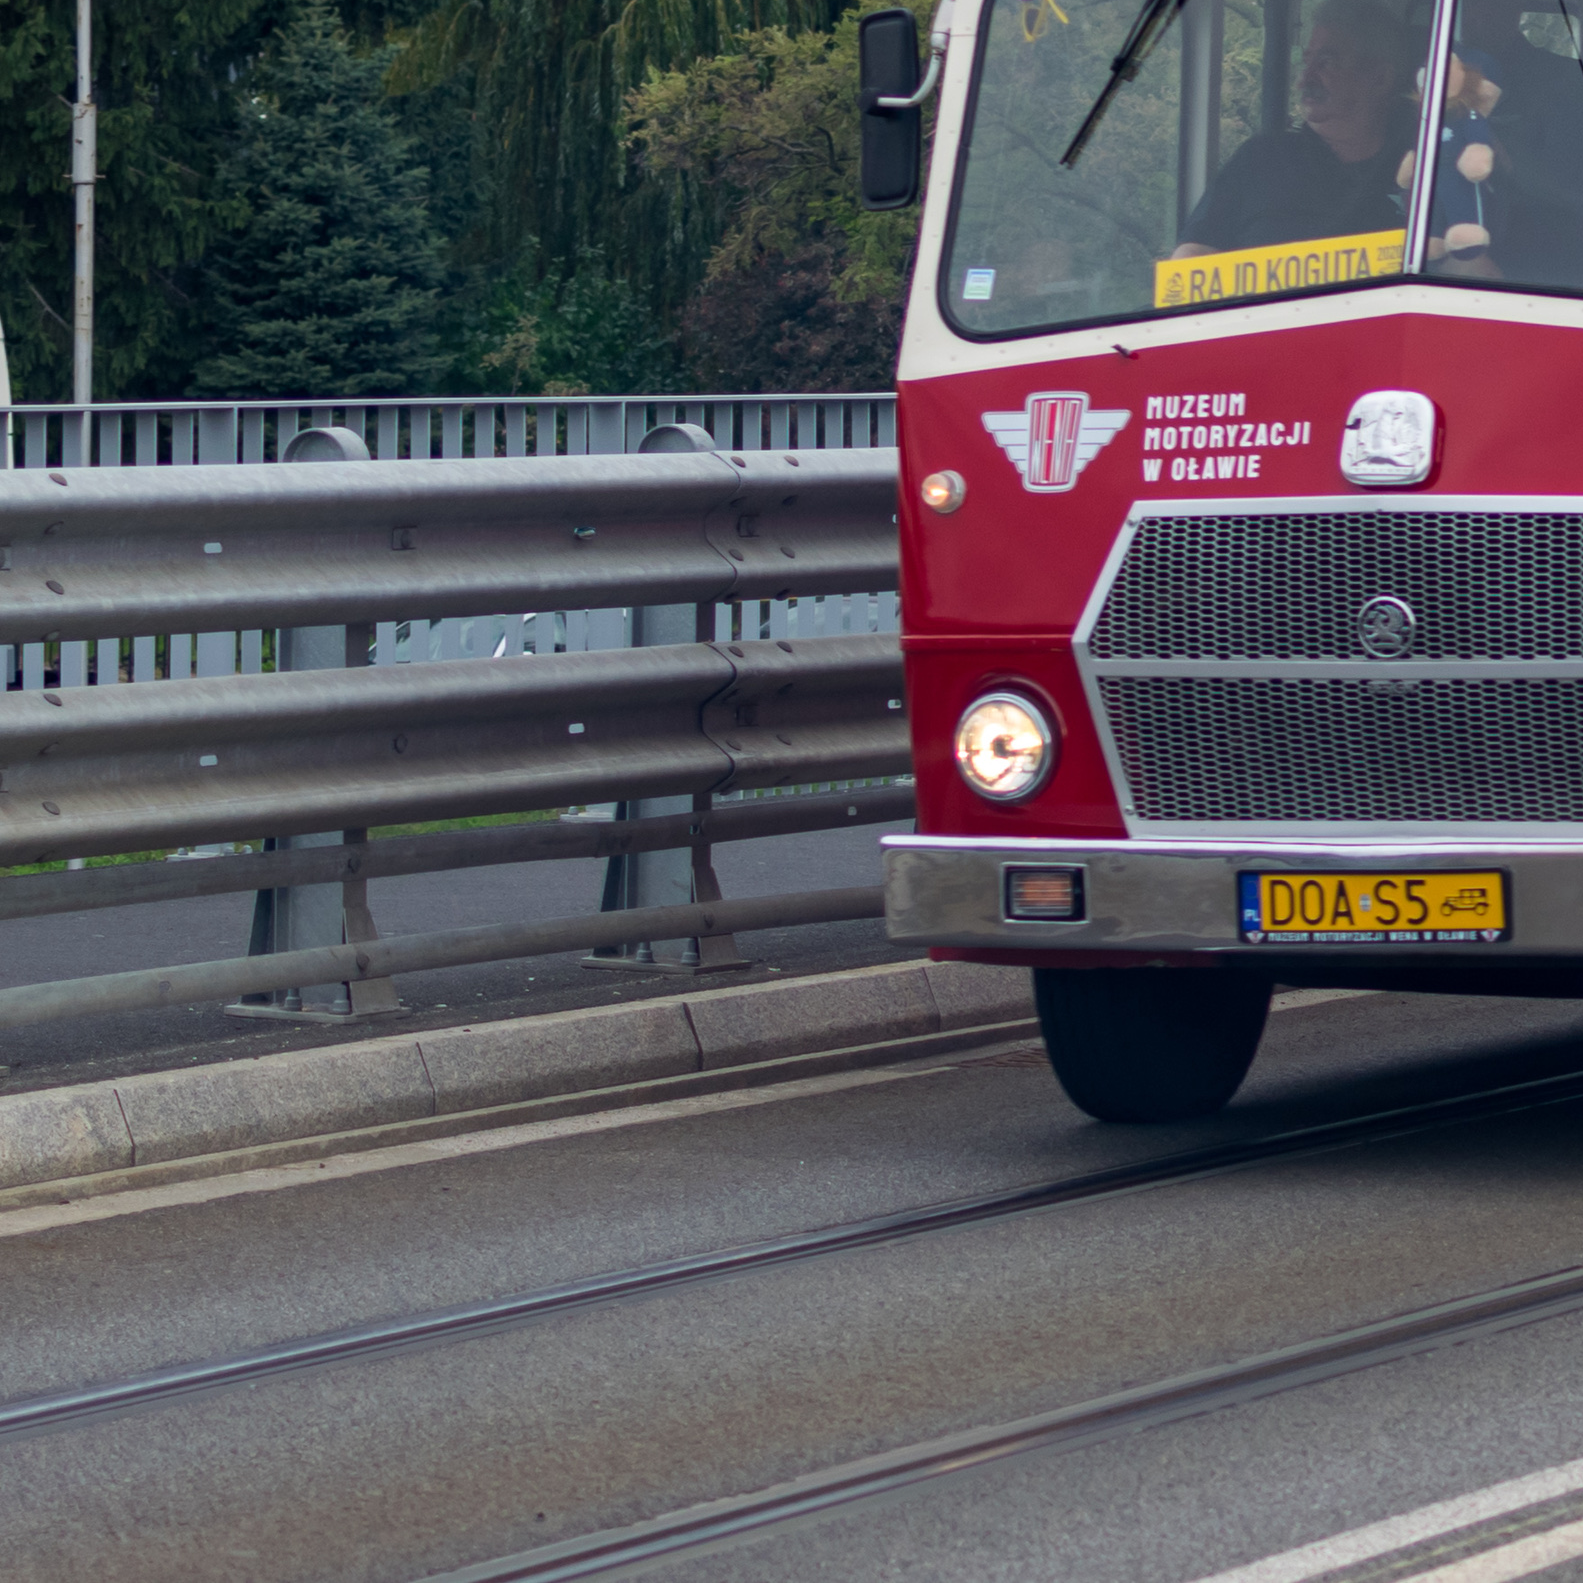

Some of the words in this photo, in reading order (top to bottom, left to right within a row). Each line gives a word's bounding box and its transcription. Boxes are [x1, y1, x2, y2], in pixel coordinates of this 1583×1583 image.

[1189, 261, 1258, 303] RAJD
[1265, 247, 1371, 293] KOGUTA
[1146, 393, 1246, 419] MUZEUM
[1144, 421, 1311, 451] MOTORYZACJI
[1142, 458, 1163, 482] W
[1170, 454, 1262, 481] OŁAWIE
[1244, 908, 1261, 922] PL
[1269, 878, 1355, 926] DOA
[1373, 878, 1429, 926] S5
[1267, 931, 1310, 942] MUZEUM
[1312, 931, 1386, 942] MOTORYZACJI
[1388, 930, 1420, 941] WENA
[1423, 930, 1433, 941] W
